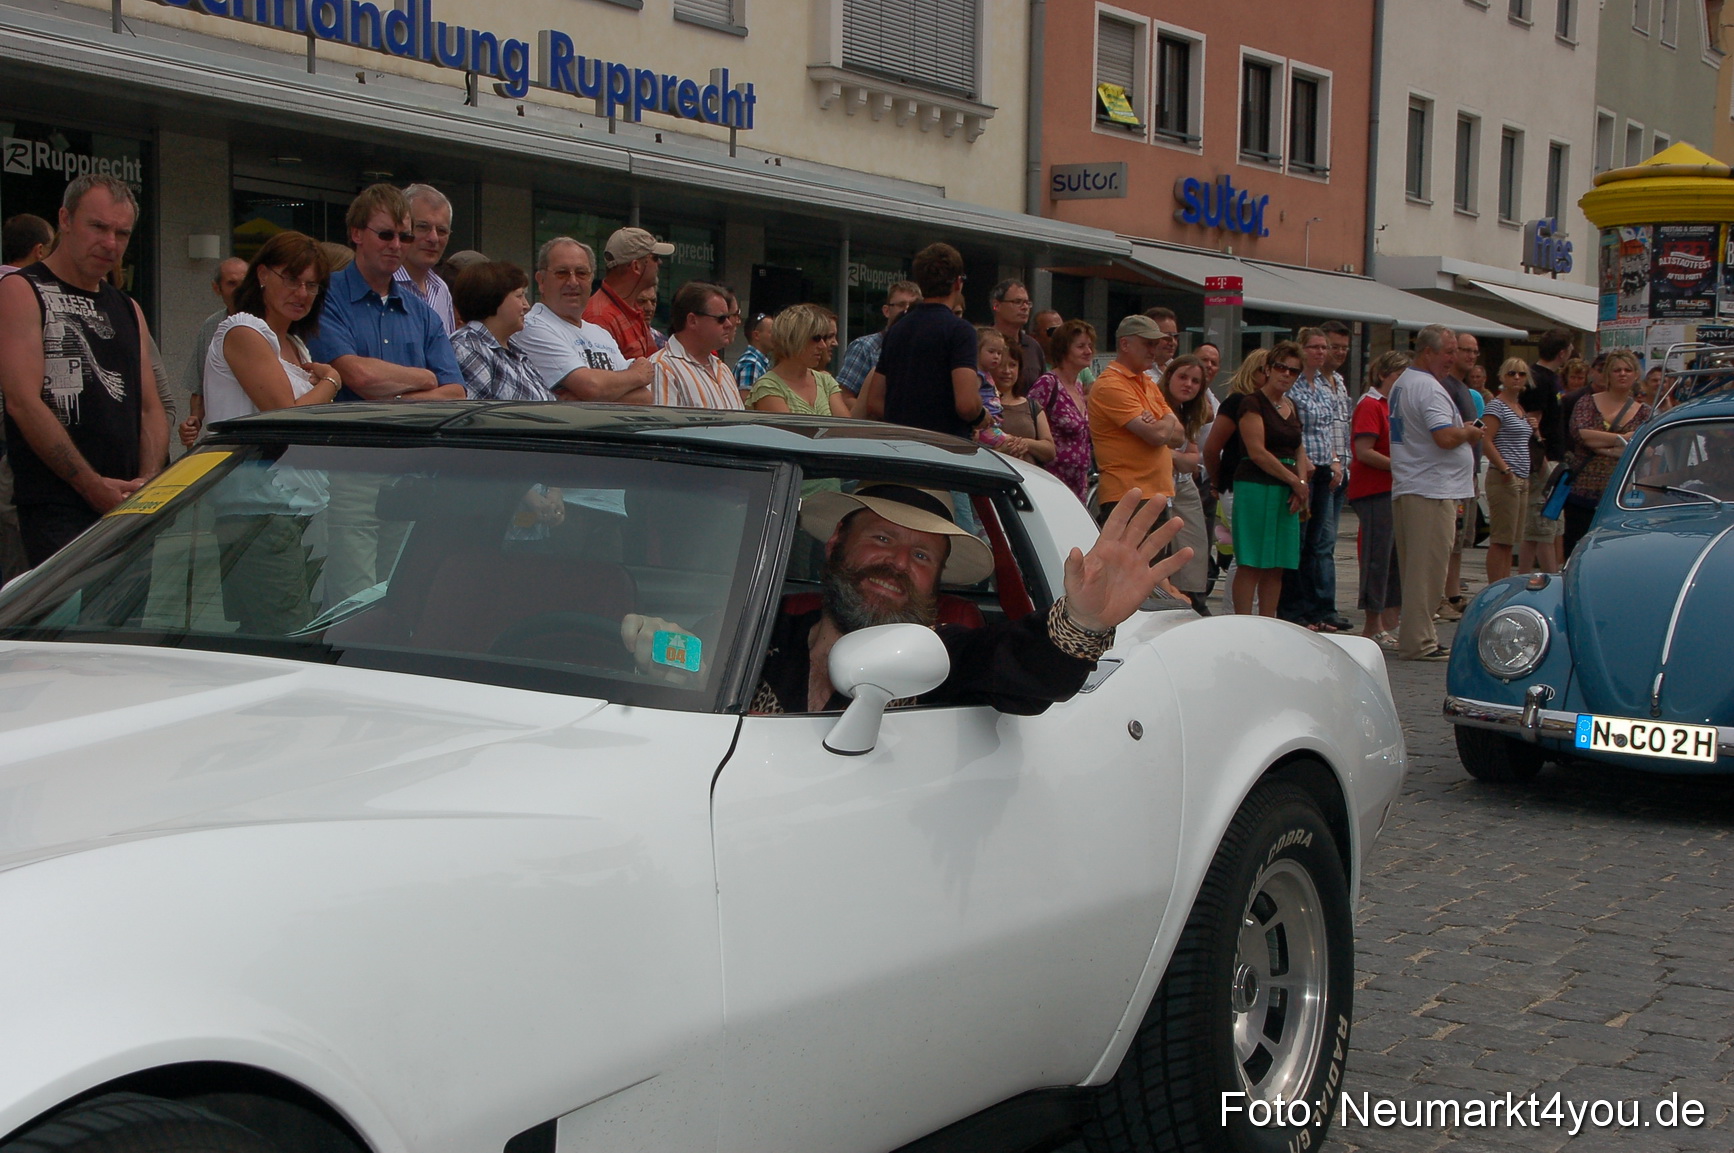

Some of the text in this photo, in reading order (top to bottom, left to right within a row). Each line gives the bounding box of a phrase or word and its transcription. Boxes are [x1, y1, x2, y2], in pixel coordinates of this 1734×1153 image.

[160, 0, 757, 130] andlung Rupprecht
[35, 141, 142, 182] Rupprecht
[1053, 169, 1118, 192] sutor.
[1182, 174, 1270, 237] sutor.
[656, 235, 714, 264] pprecht
[1533, 217, 1573, 273] fries
[1658, 256, 1711, 269] ALTSTADTFEST
[1667, 272, 1702, 280] AFTER PARTY
[860, 264, 907, 289] Rupprecht
[1618, 304, 1640, 313] 24.6.
[666, 646, 686, 664] 04
[1580, 734, 1588, 743] D
[1267, 828, 1313, 865] COBRA
[1311, 1013, 1348, 1126] RADIAL
